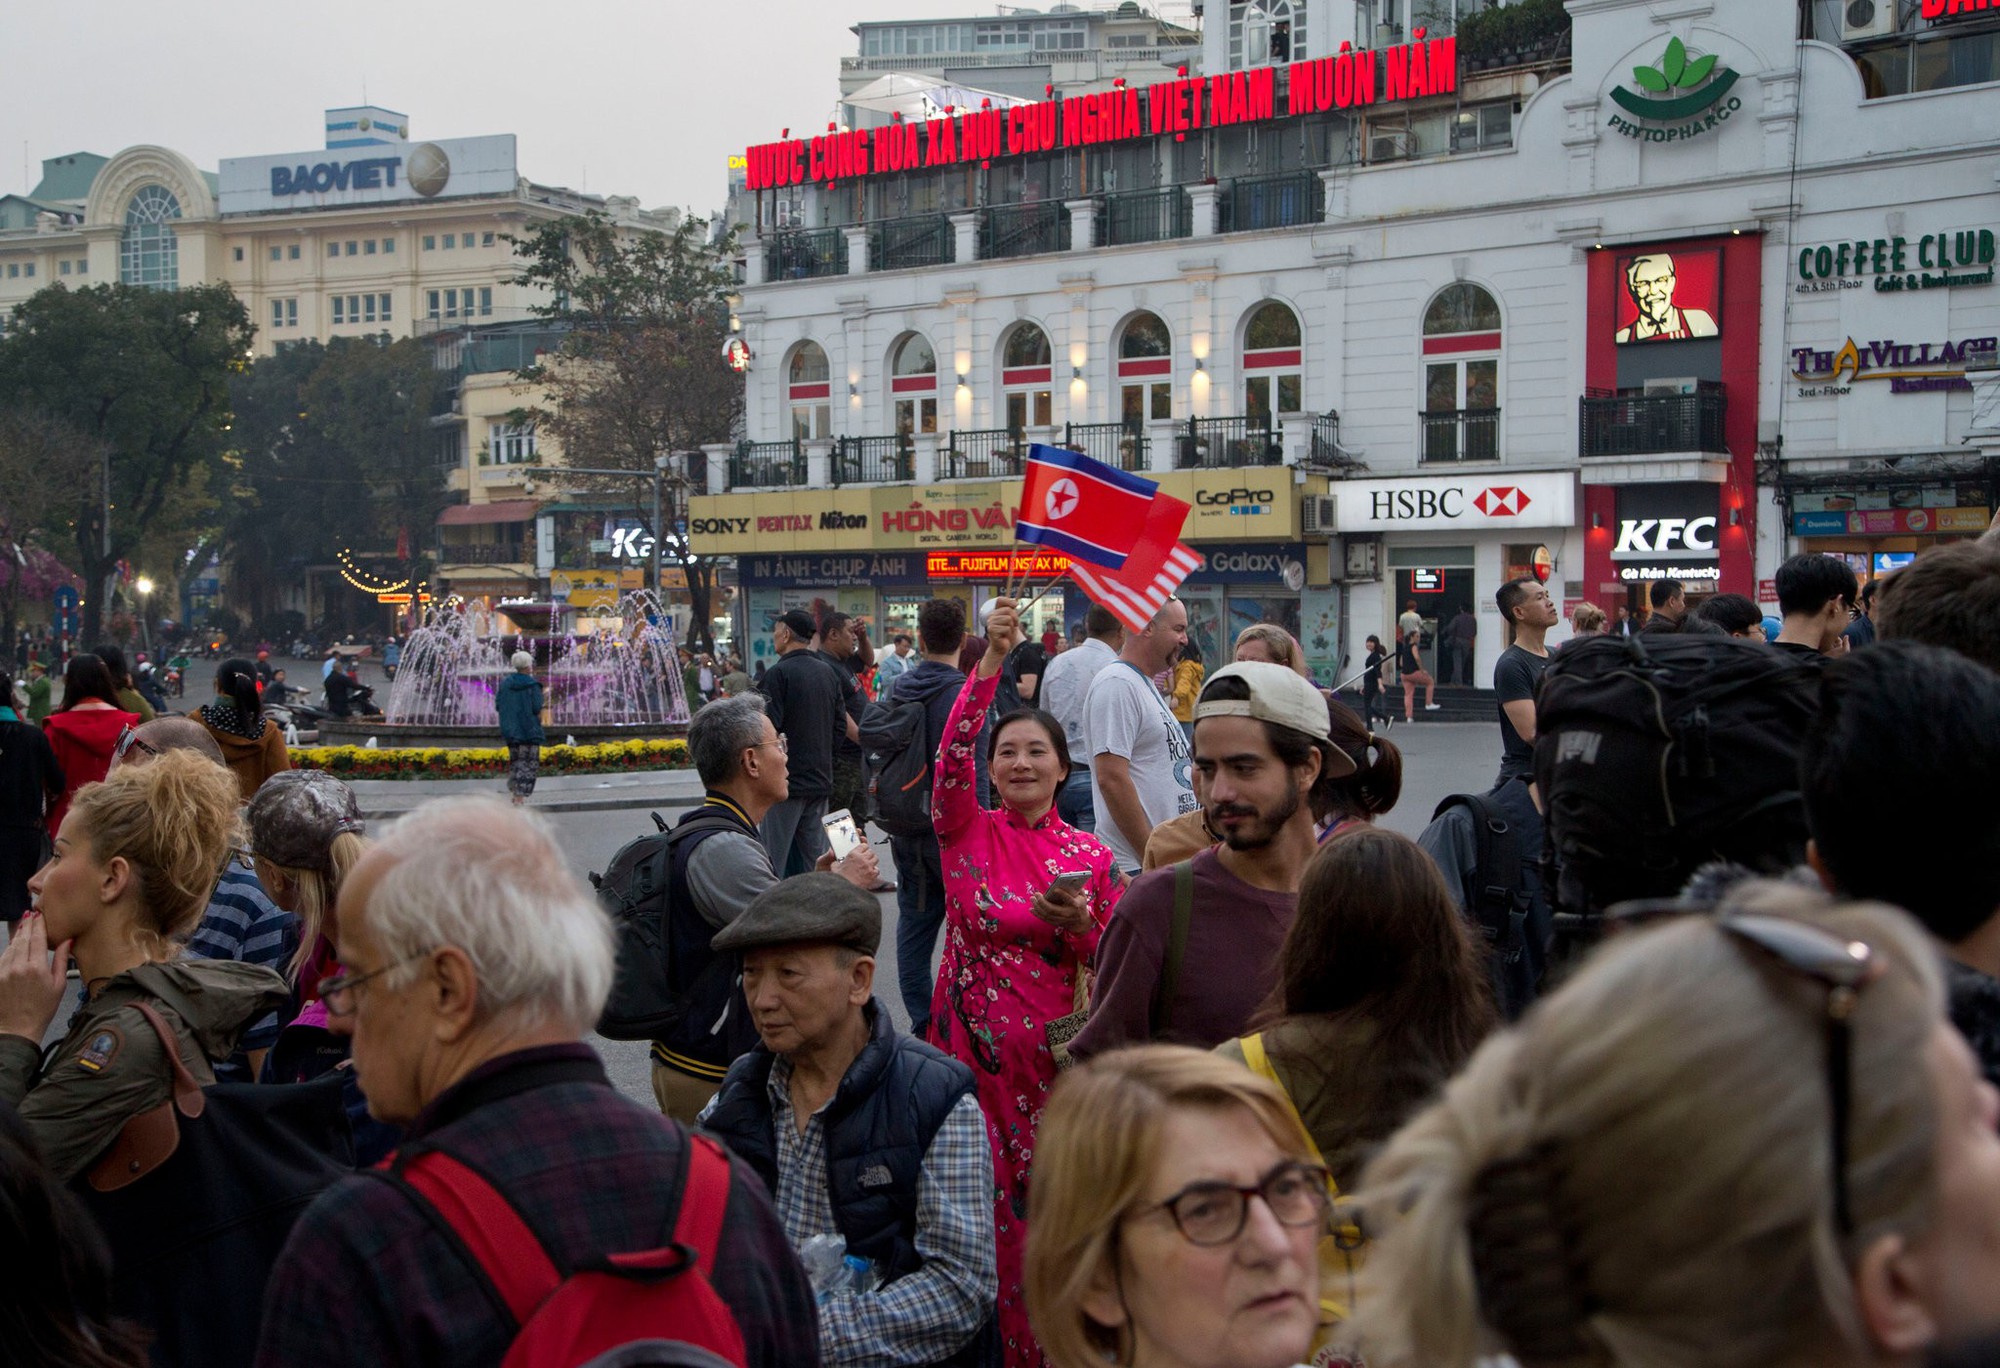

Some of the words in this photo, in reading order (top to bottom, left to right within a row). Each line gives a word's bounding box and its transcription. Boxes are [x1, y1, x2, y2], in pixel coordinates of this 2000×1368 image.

[746, 128, 804, 190] NƯỚC
[810, 122, 868, 190] CỘNG
[925, 105, 957, 166] XÃ
[961, 97, 1001, 170] HỘI
[1007, 83, 1055, 154] CHỦ
[1063, 78, 1141, 147] NGHĨA
[1150, 65, 1206, 142] VIỆT
[1210, 66, 1275, 126] NAM
[1288, 40, 1376, 115] MUÔN
[1386, 26, 1457, 101] NĂM
[1607, 96, 1742, 143] PHYTOPHARCO
[270, 156, 402, 196] BAOVIET
[1799, 237, 1907, 281] COFFEE
[1918, 228, 1996, 269] CLUB
[1795, 282, 1809, 293] 4th
[1812, 281, 1819, 292] &
[1820, 281, 1835, 292] 5th
[1838, 279, 1864, 290] Floor
[1906, 273, 1919, 290] &
[1798, 387, 1816, 397] 3rd
[1824, 386, 1851, 396] Floor
[1196, 488, 1274, 505] GoPro
[1369, 487, 1464, 520] HSBC
[692, 518, 750, 534] SONY
[757, 514, 813, 532] PENTAX
[819, 510, 867, 530] Nikon
[882, 501, 967, 533] HỒNG
[920, 535, 941, 543] DIGITAL
[946, 534, 971, 542] CAMERA
[975, 533, 998, 541] WORLD
[1614, 516, 1717, 552] KFC
[755, 561, 771, 577] IN
[961, 557, 1008, 571] FUJIFILM
[1212, 552, 1289, 576] Galaxy
[1621, 568, 1639, 579] Gà
[1666, 567, 1720, 580] Kentucky
